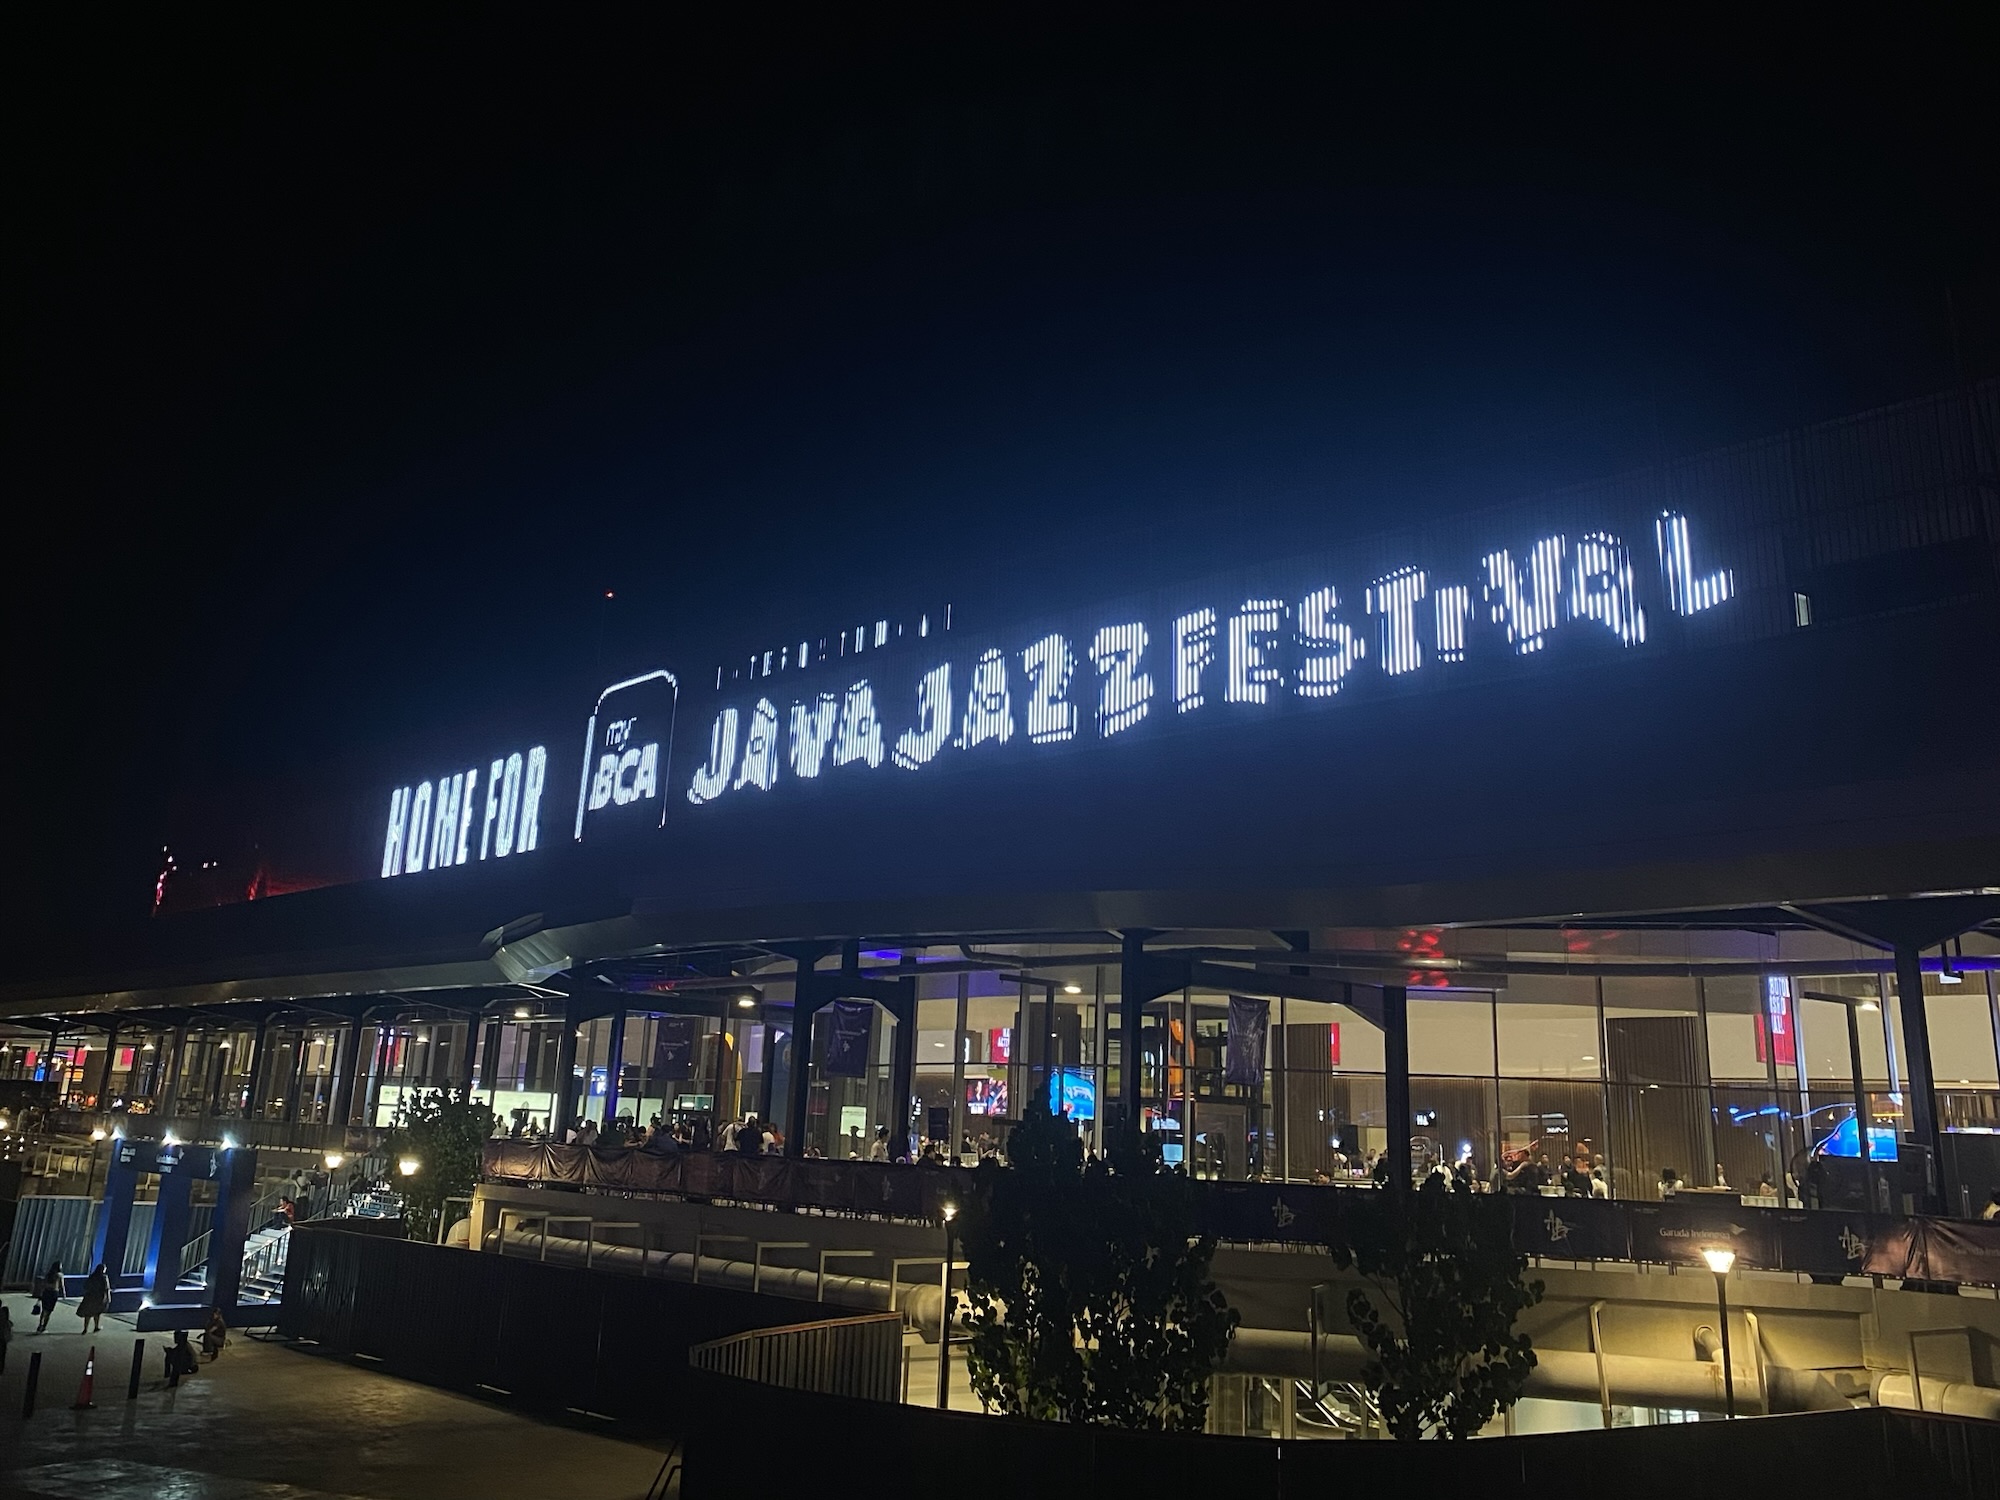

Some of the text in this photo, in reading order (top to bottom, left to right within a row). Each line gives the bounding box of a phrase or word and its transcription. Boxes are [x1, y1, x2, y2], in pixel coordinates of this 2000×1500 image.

[588, 743, 660, 811] BCA
[687, 679, 887, 805] JAVA
[381, 745, 547, 878] HOME FOR
